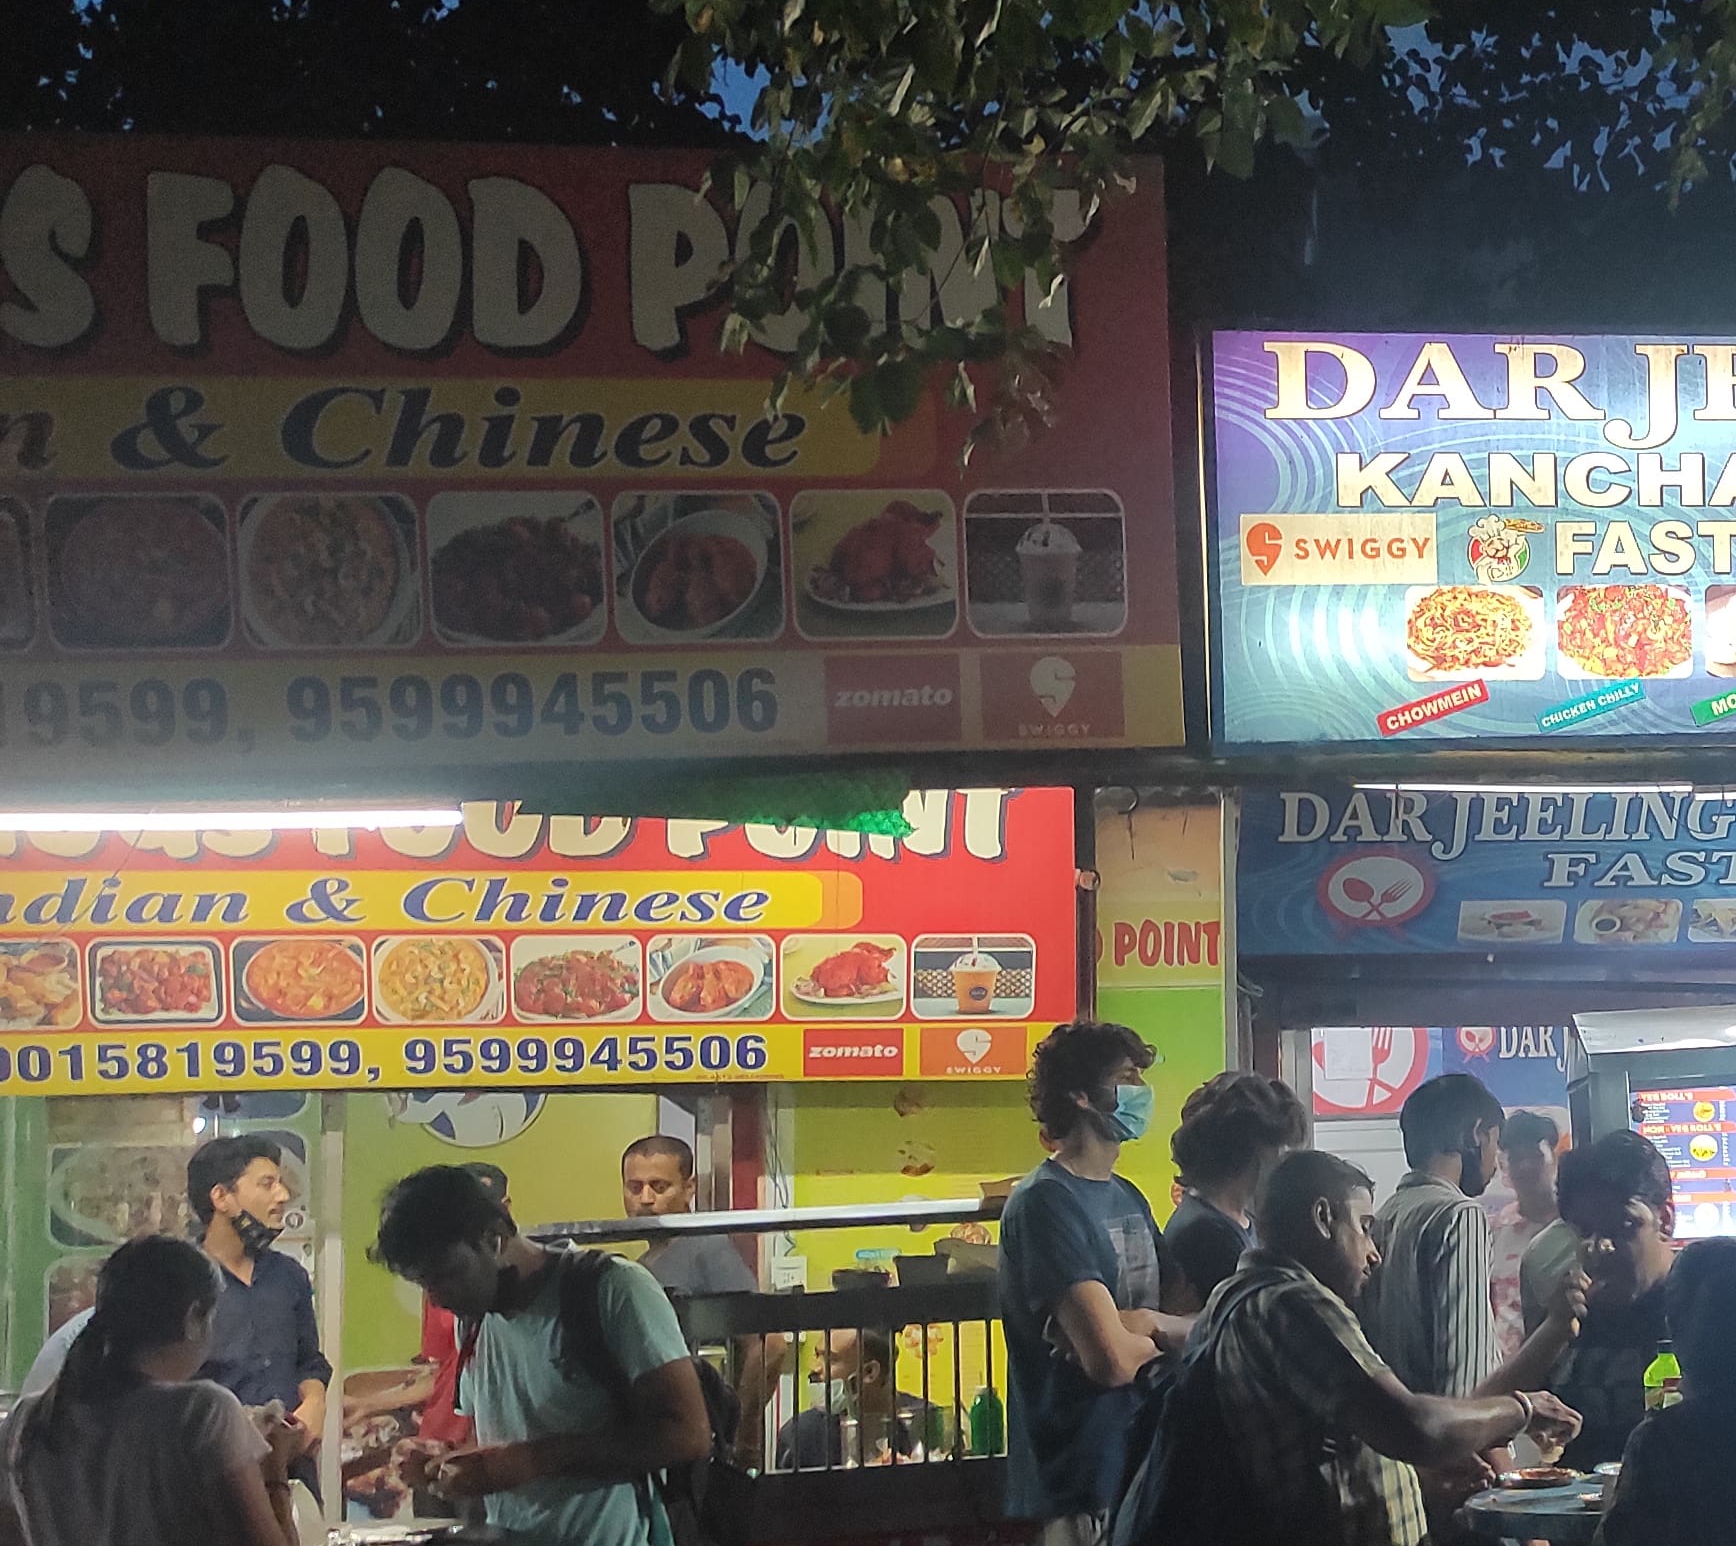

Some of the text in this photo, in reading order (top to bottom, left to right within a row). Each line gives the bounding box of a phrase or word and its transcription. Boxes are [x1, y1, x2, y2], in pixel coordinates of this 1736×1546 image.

[146, 163, 584, 350] FOOD
[110, 386, 227, 471] &
[281, 386, 806, 469] Chinese
[1294, 537, 1431, 560] SWIGGY
[286, 668, 779, 743] 9599945506
[834, 684, 953, 709] zomato
[1385, 683, 1482, 731] CHOWMEIN
[1541, 682, 1641, 728] CHICKEN CHILLY
[1018, 723, 1091, 738] SWIGGY
[285, 876, 367, 924] &
[402, 877, 770, 924] Chinese
[1113, 918, 1221, 967] POINT
[403, 1033, 769, 1079] 9599945506
[808, 1044, 899, 1059] zomato
